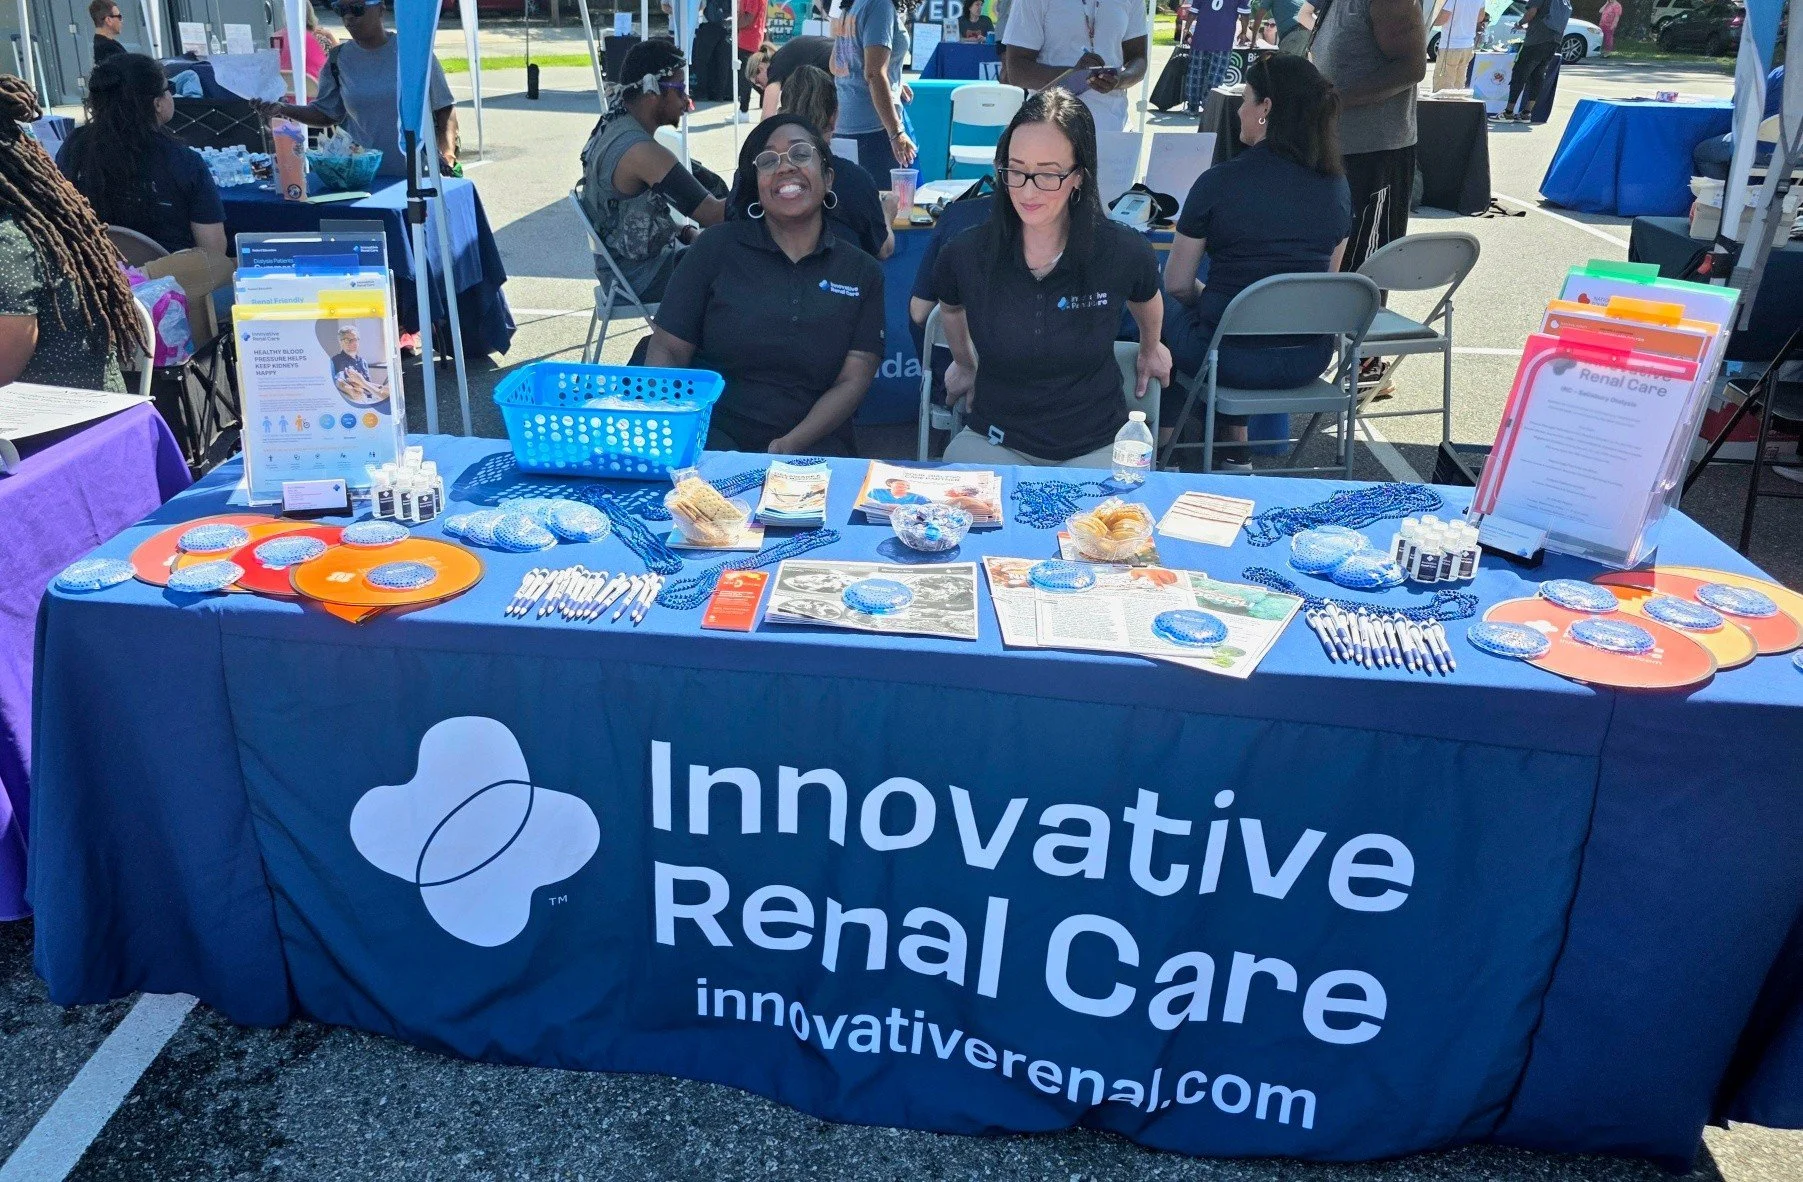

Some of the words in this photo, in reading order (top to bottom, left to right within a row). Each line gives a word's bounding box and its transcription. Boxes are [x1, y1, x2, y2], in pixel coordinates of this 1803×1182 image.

[273, 297, 304, 305] Friendly
[1579, 368, 1625, 388] Renal
[1627, 378, 1668, 398] Care
[652, 740, 1415, 912] Innovative
[548, 894, 568, 906] TM
[655, 861, 1009, 998] Renal
[1046, 914, 1388, 1044] Care
[697, 977, 1316, 1129] innovativerenal.com
